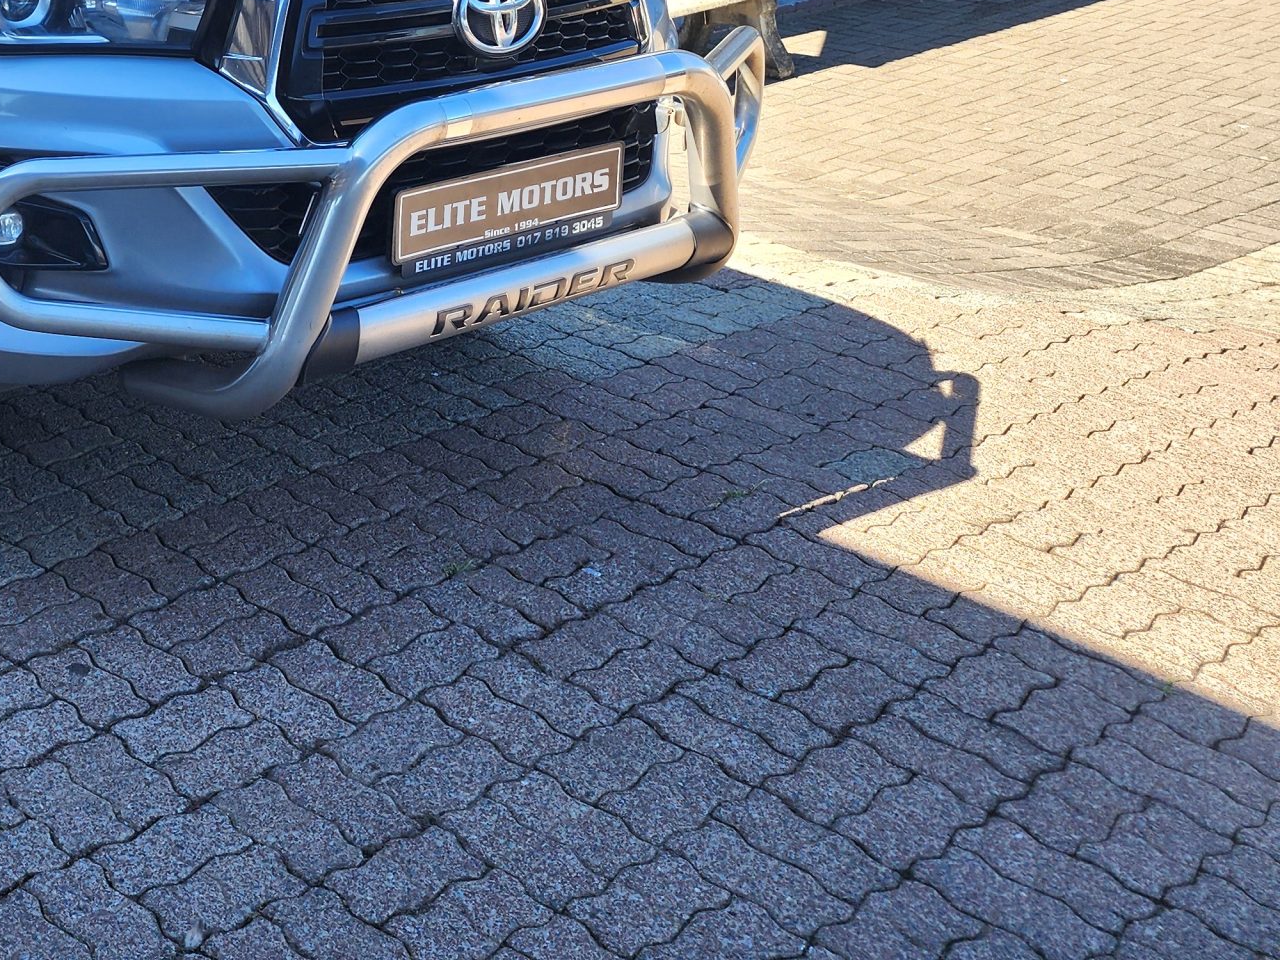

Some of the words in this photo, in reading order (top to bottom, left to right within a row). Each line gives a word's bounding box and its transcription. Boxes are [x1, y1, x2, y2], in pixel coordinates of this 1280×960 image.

[410, 196, 487, 237] ELITE
[497, 168, 609, 216] MOTORS
[484, 227, 510, 239] Since
[514, 218, 540, 232] 1994
[415, 254, 451, 273] ELITE
[455, 239, 511, 263] MOTORS
[517, 233, 541, 248] 017
[545, 226, 569, 241] 819
[572, 216, 603, 234] 3045
[430, 257, 636, 338] RAIDER
